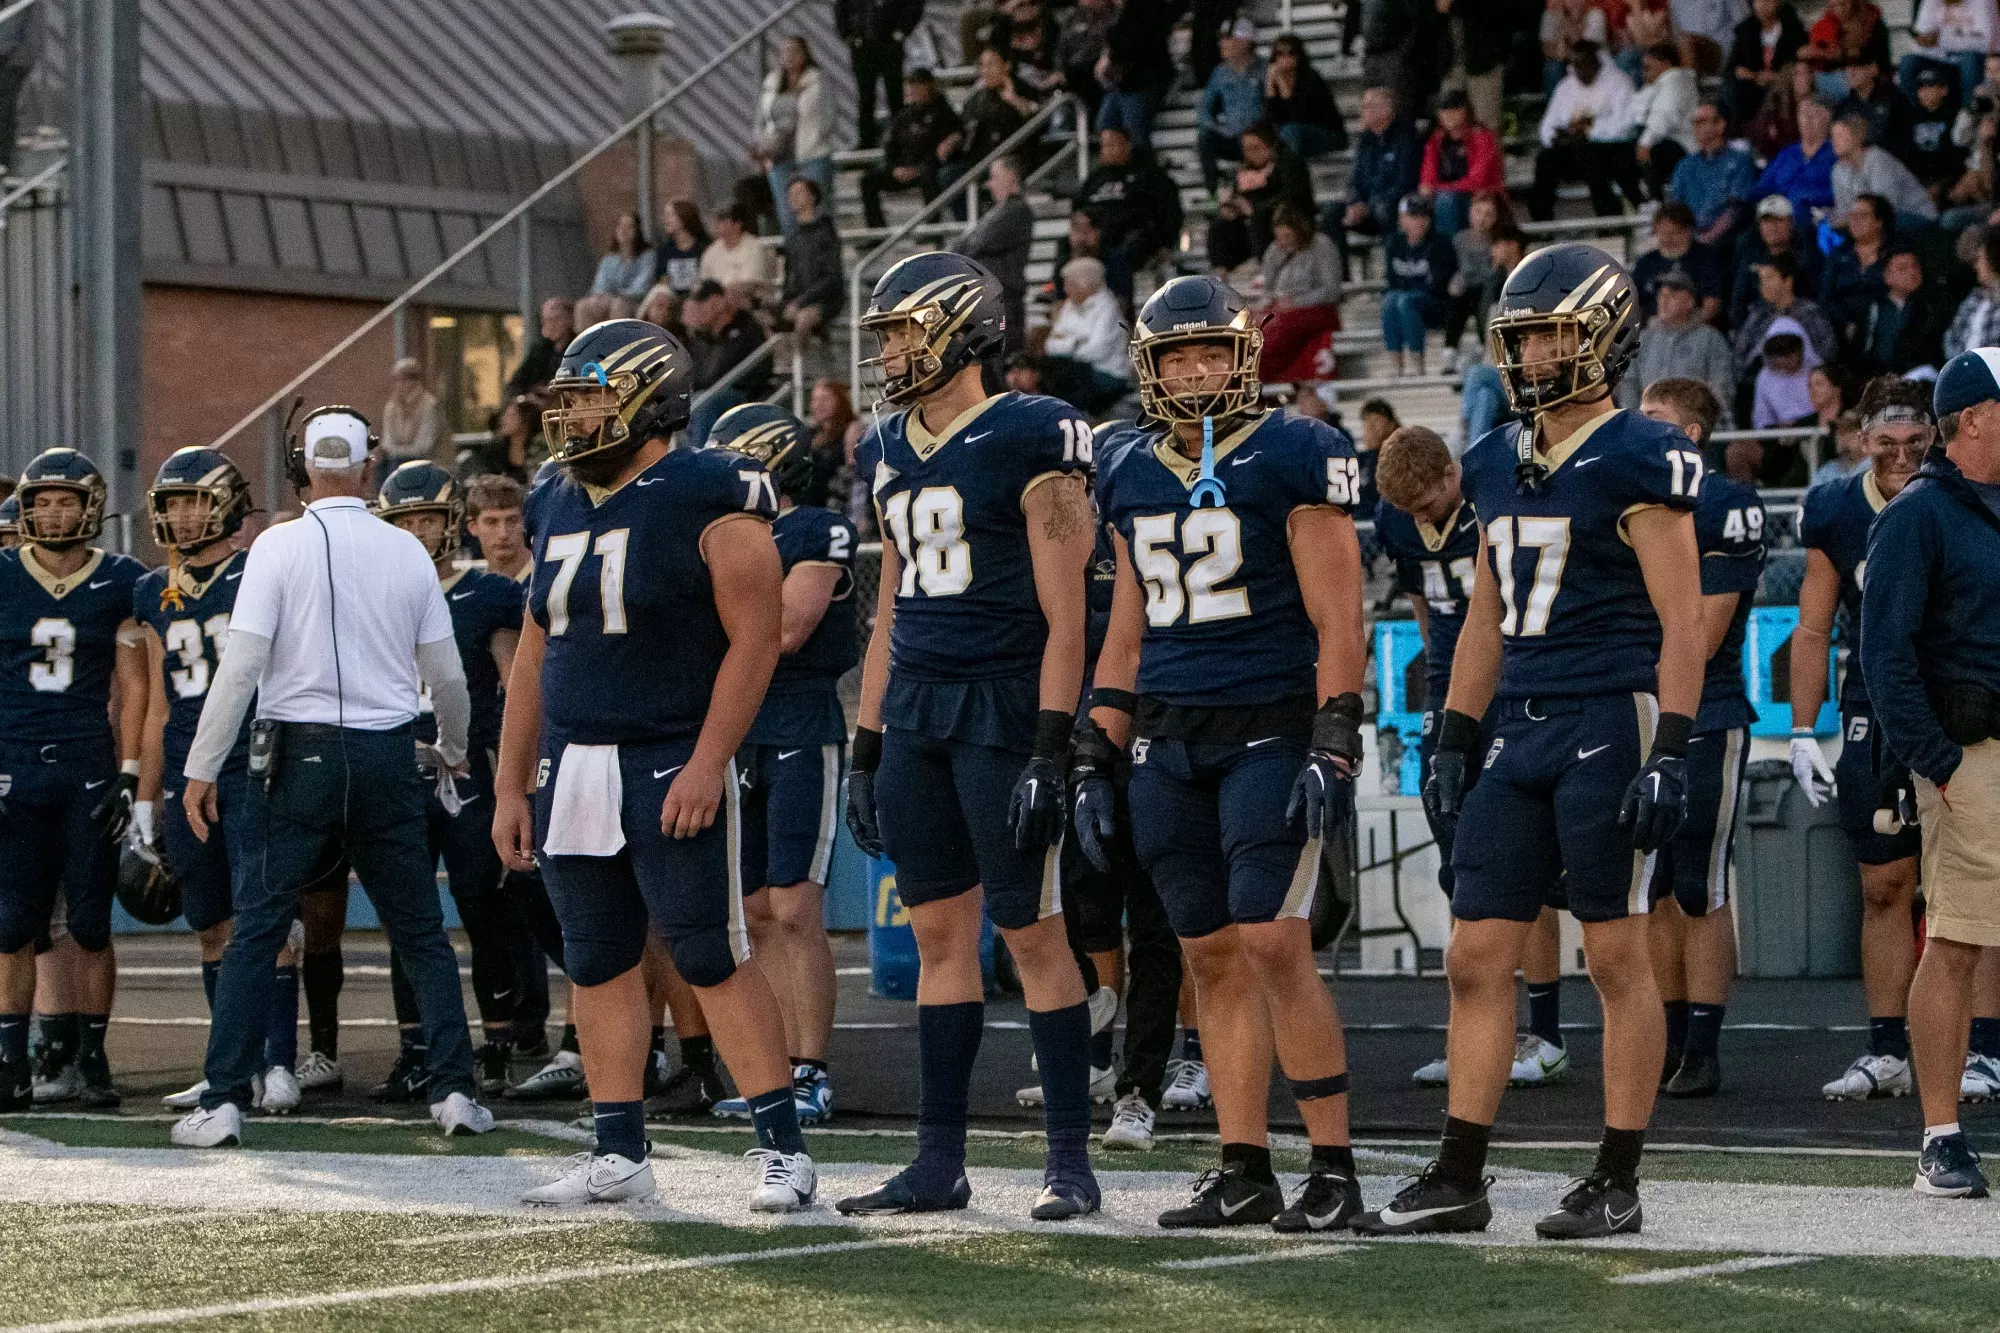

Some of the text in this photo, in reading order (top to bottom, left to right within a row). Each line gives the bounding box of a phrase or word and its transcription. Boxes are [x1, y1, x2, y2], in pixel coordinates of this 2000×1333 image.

[1173, 320, 1207, 330] Riddell
[1058, 418, 1093, 463] 18
[738, 469, 778, 511] 71
[1326, 457, 1360, 505] 52
[1665, 449, 1703, 497] 17
[828, 525, 850, 558] 2
[884, 486, 973, 597] 18
[1723, 506, 1763, 543] 49
[544, 528, 630, 636] 71
[1133, 507, 1252, 627] 52
[1487, 516, 1571, 636] 17
[29, 617, 76, 693] 3
[166, 612, 231, 699] 31
[1847, 716, 1869, 742] G
